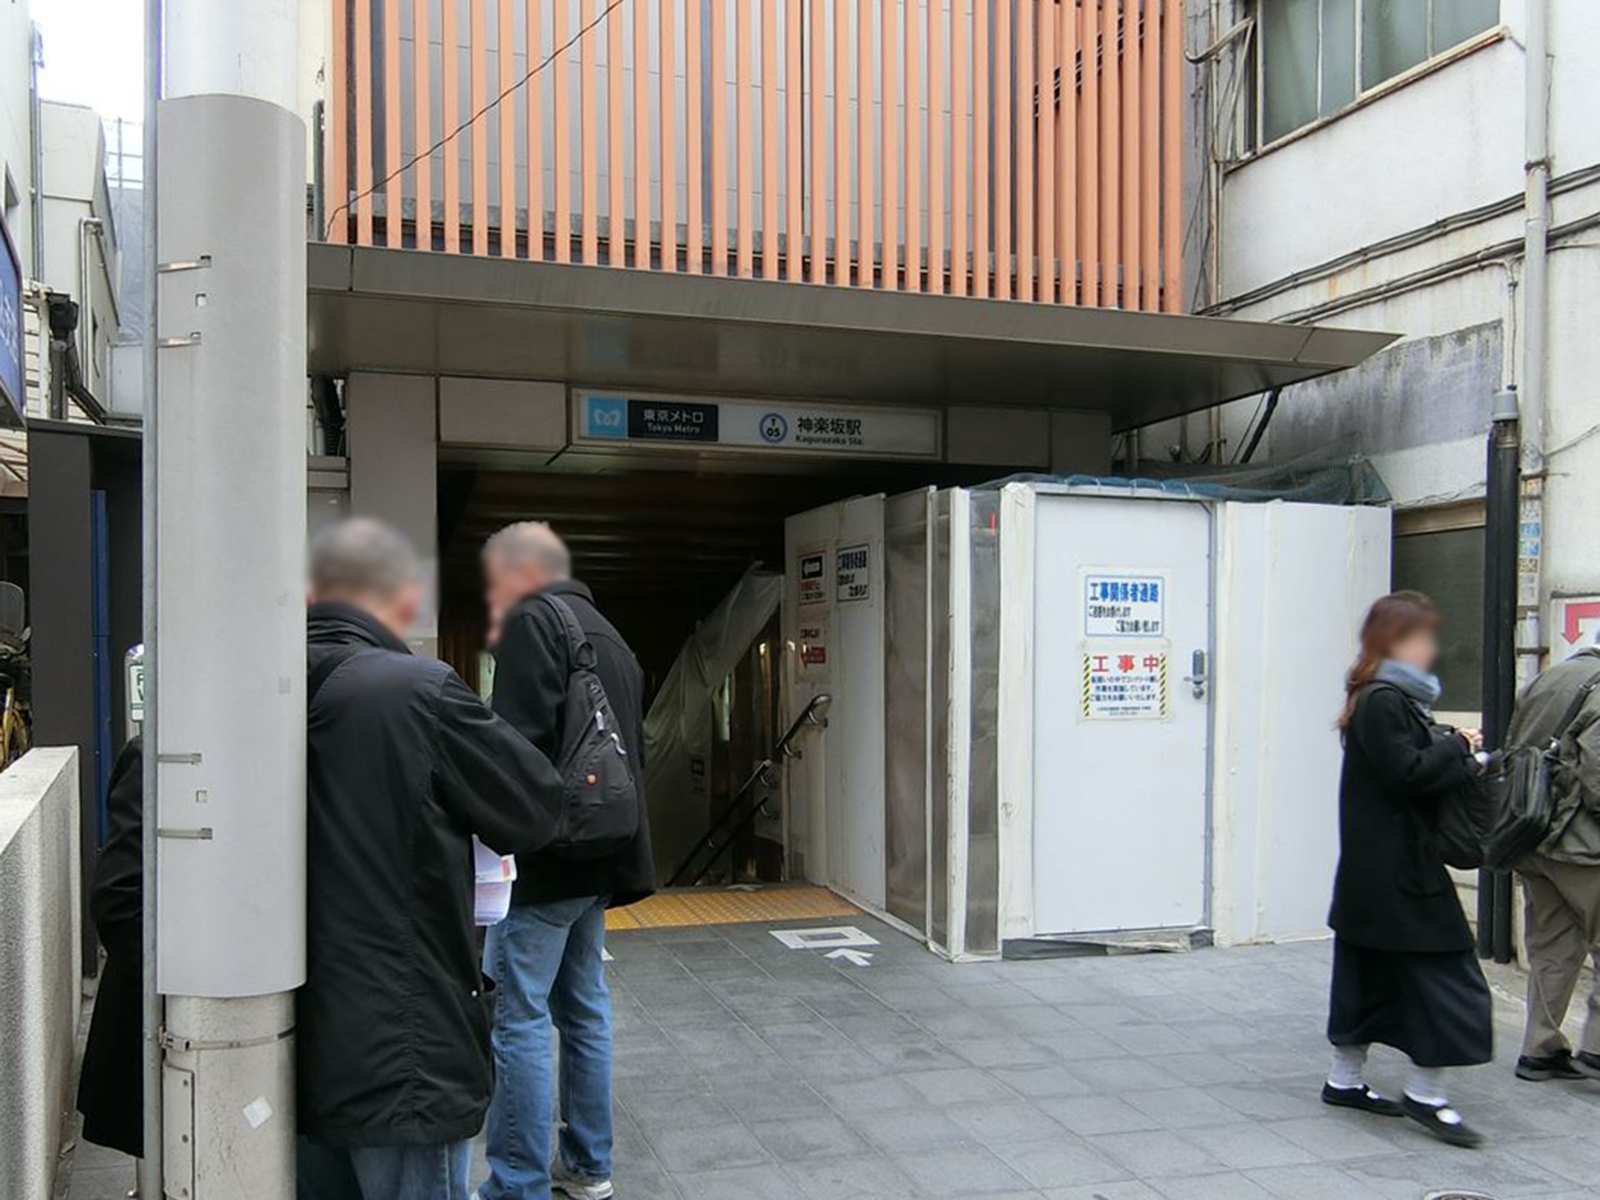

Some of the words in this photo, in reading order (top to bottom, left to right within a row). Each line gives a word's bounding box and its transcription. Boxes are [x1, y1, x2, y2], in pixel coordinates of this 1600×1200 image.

[643, 408, 704, 424] 東京メトロ
[645, 422, 673, 433] Tokyo
[674, 423, 701, 435] Metro
[766, 427, 780, 437] 05
[797, 417, 862, 436] 神楽坂駅
[796, 435, 847, 445] Kagurazaka
[1089, 582, 1159, 603] 工事関係者通路
[1091, 654, 1159, 673] 工事中
